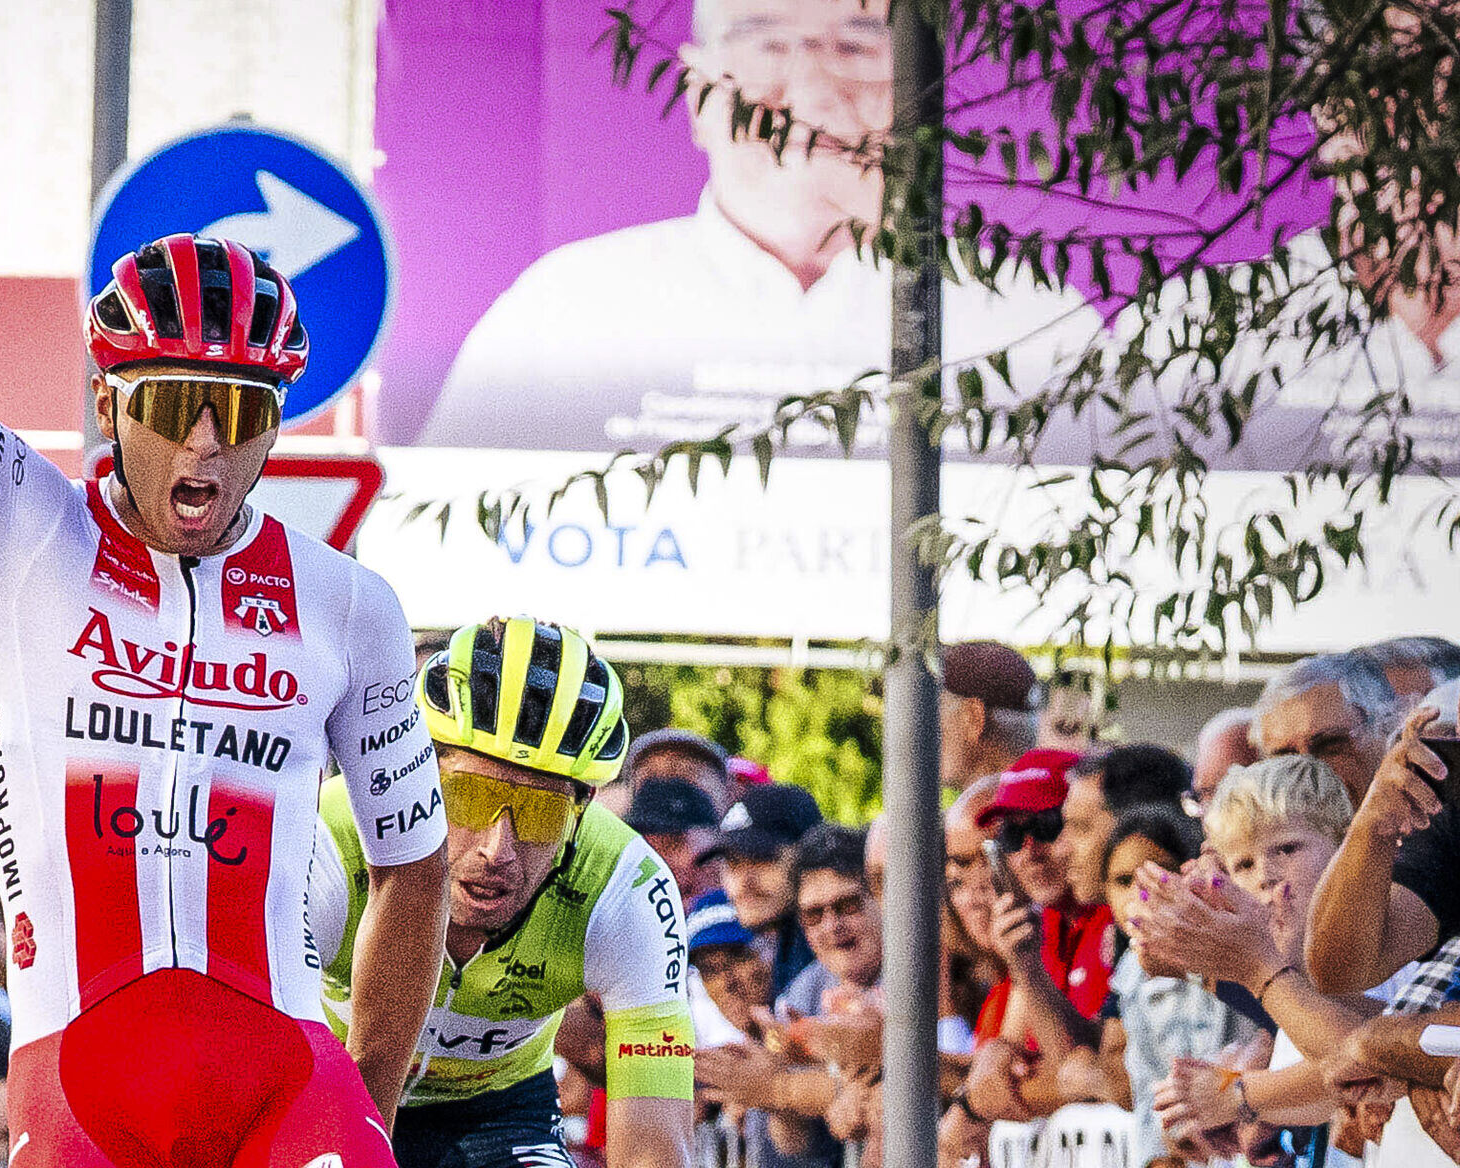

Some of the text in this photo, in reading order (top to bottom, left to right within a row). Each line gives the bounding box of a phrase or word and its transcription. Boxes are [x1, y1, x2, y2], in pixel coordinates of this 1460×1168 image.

[250, 573, 291, 588] PACTO
[497, 520, 688, 571] VOTA
[67, 606, 299, 711] Aviludo
[65, 697, 292, 773] LOULETANO
[93, 774, 247, 866] loulé
[647, 877, 686, 994] tavfer
